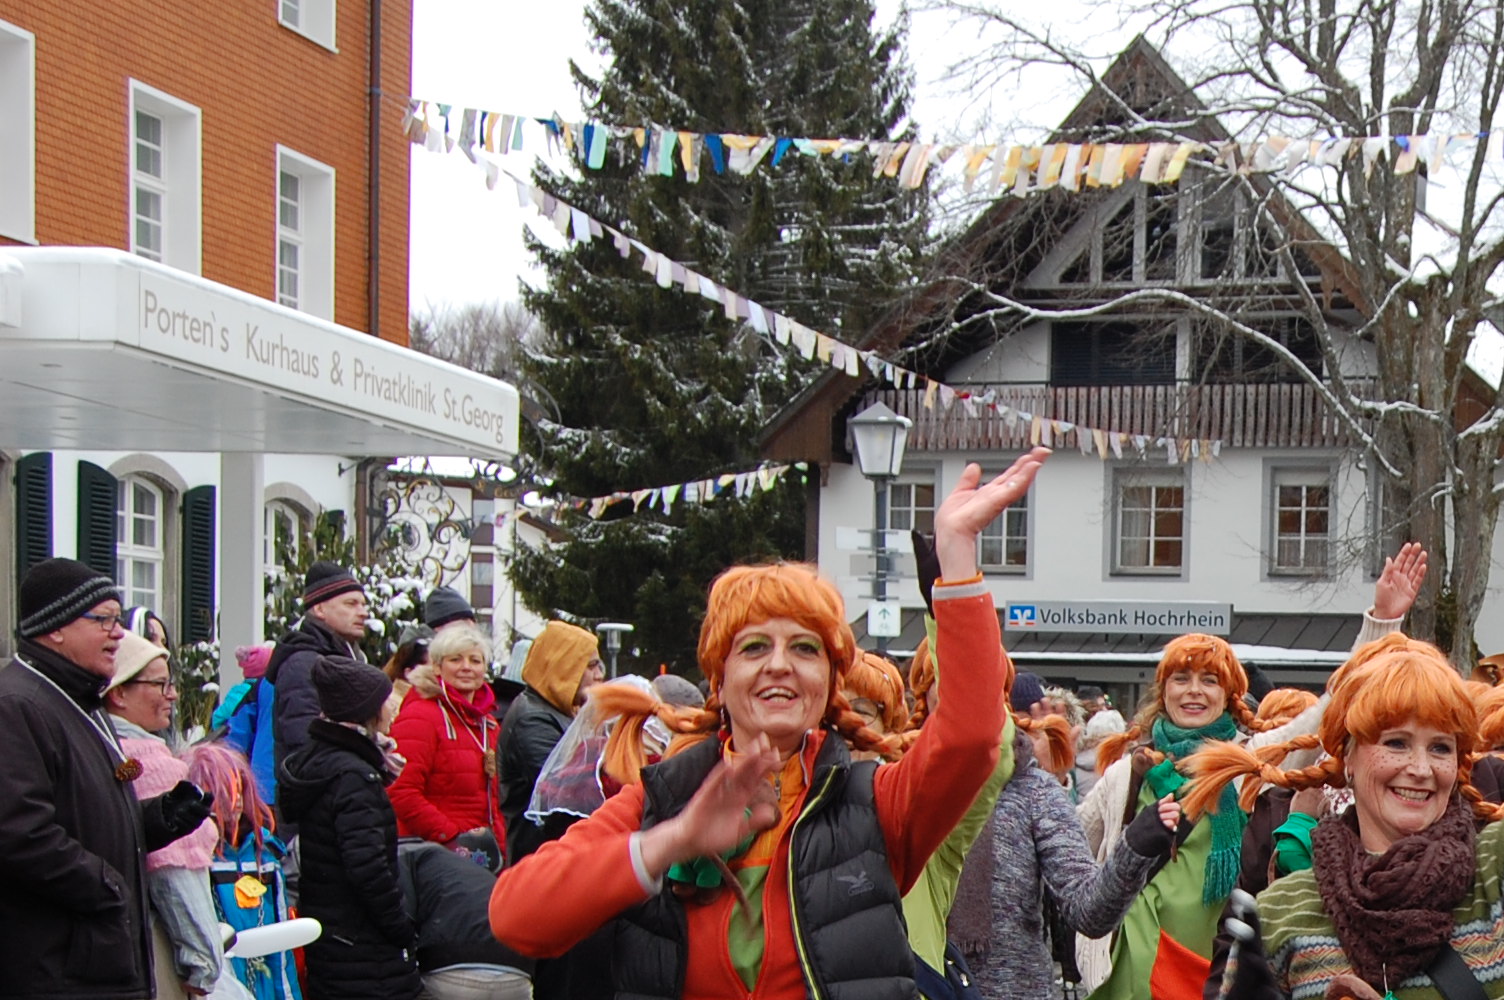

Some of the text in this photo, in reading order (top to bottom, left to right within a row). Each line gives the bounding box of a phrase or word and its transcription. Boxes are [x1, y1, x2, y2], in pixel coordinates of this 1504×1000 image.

[246, 322, 319, 379] Kurhaus
[330, 350, 343, 387] &
[353, 358, 436, 414] Privatklinik
[1040, 607, 1224, 627] Volksbank Hochrhein
